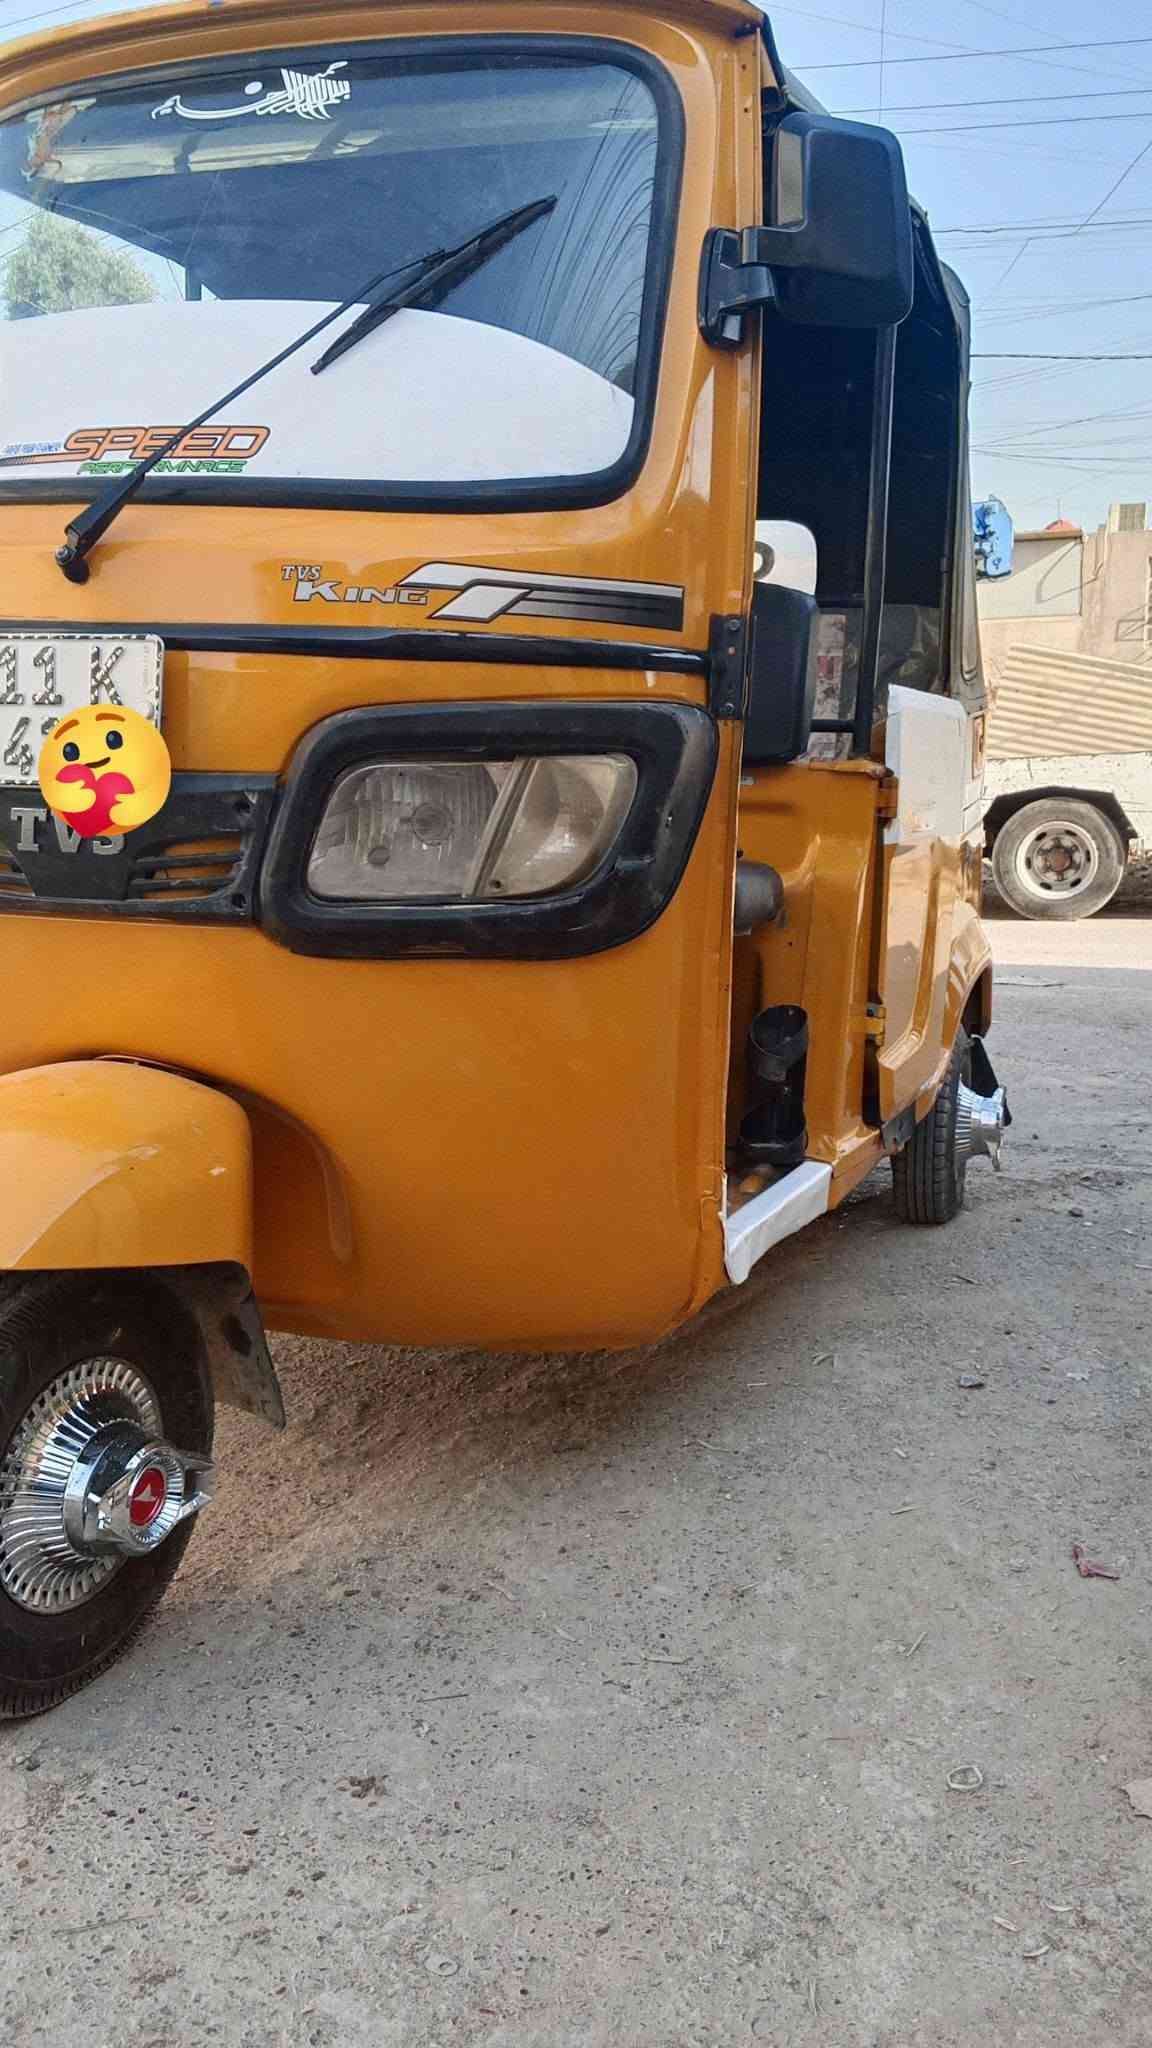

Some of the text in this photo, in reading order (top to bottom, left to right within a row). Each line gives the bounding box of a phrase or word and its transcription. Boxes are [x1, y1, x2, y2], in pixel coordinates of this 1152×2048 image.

[64, 426, 271, 460] SPEED
[77, 460, 248, 475] PERFRMNACE
[282, 564, 321, 580] TVS
[293, 580, 429, 605] KING
[90, 646, 124, 705] K
